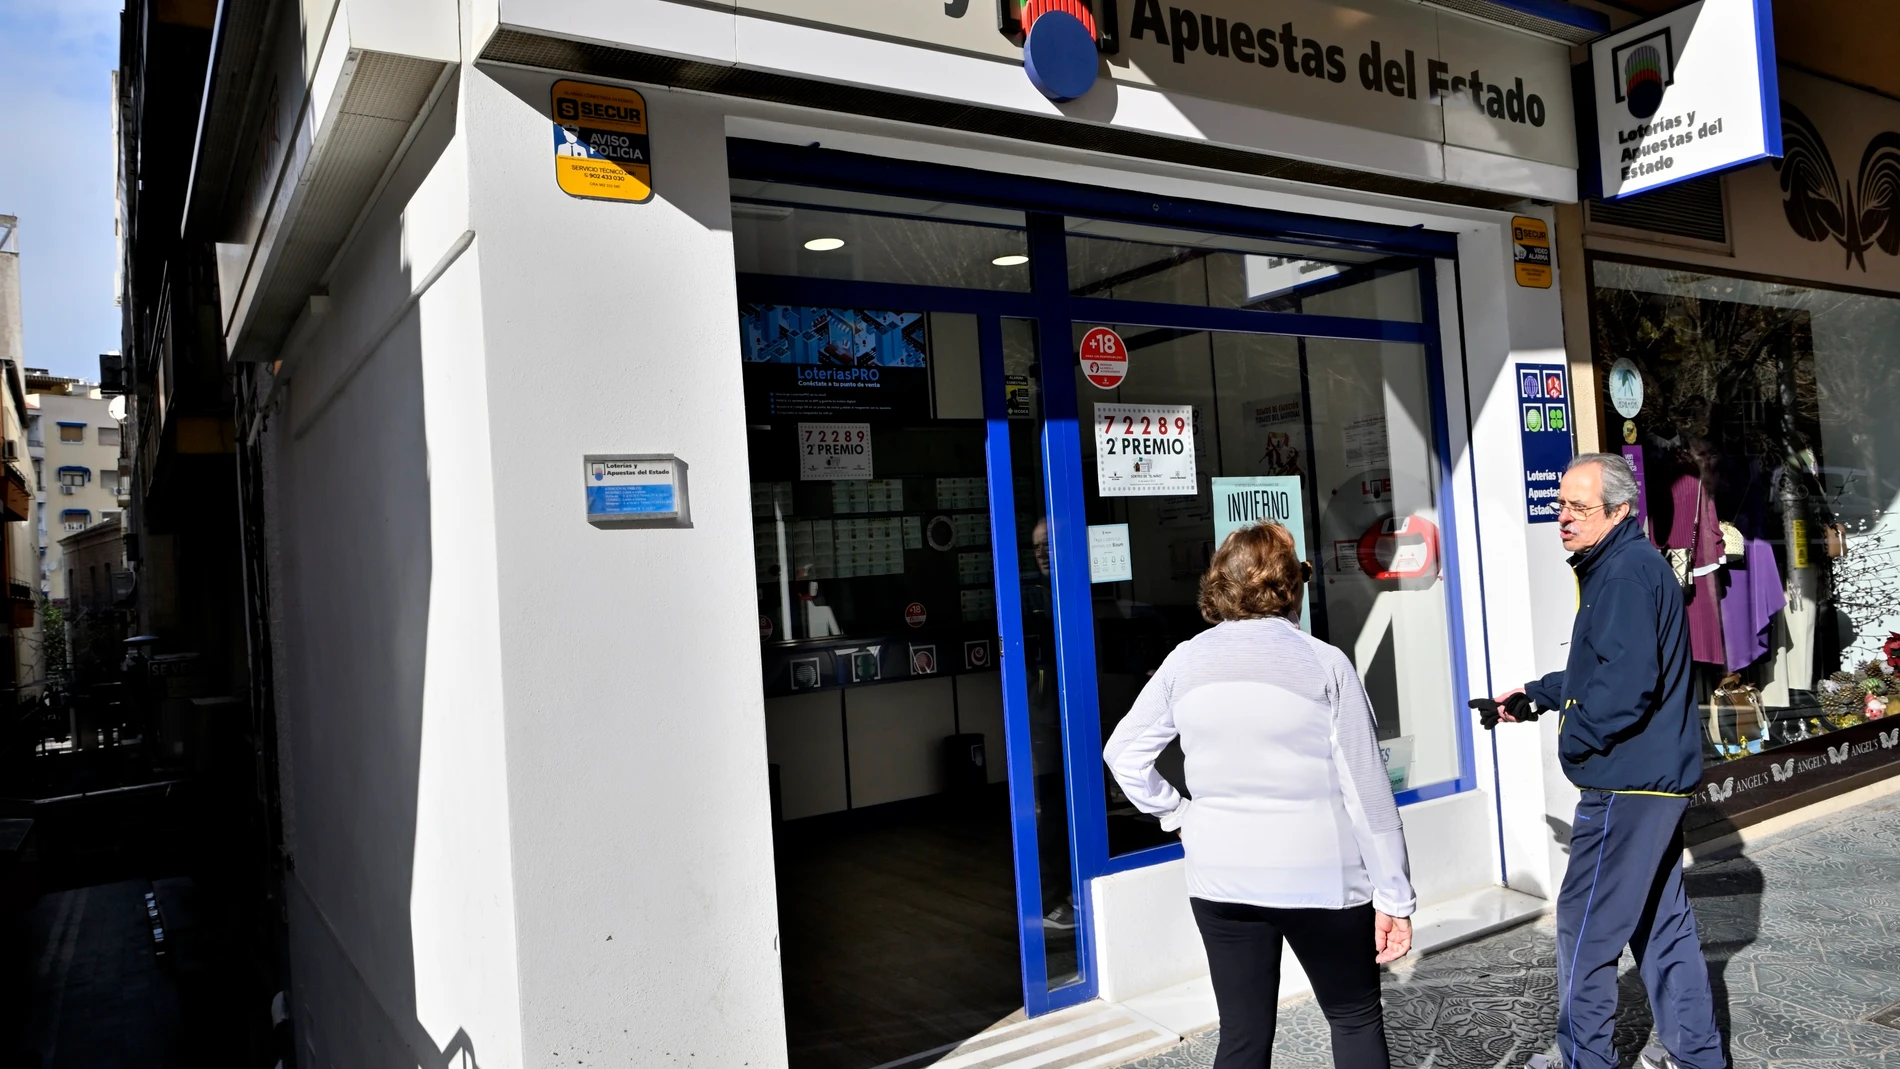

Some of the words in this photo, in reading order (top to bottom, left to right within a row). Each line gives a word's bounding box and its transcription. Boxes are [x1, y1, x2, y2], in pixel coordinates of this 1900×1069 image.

[1130, 0, 1346, 83] Apuestas
[1358, 40, 1417, 100] del
[1427, 57, 1546, 128] Estado
[580, 101, 640, 121] SECUR
[1618, 115, 1682, 144] Loterías
[1686, 110, 1696, 127] y
[590, 133, 630, 147] AVISO
[1620, 131, 1693, 163] Apuestas
[1698, 118, 1723, 140] del
[590, 144, 643, 160] POLICIA
[572, 164, 598, 172] SERVICIO
[1620, 156, 1674, 180] Estado
[1523, 229, 1546, 240] SECUR
[1089, 334, 1116, 354] +18
[818, 444, 864, 455] PREMIO
[1122, 438, 1184, 455] PREMIO
[1527, 469, 1556, 481] Loterías
[1557, 472, 1562, 482] y
[1228, 490, 1289, 522] INVIERNO
[1529, 505, 1553, 515] Estad
[910, 605, 921, 613] +18
[1736, 771, 1769, 793] ANGEL'S
[1797, 754, 1827, 774] ANGEL'S
[1851, 738, 1879, 757] ANGEL'S
